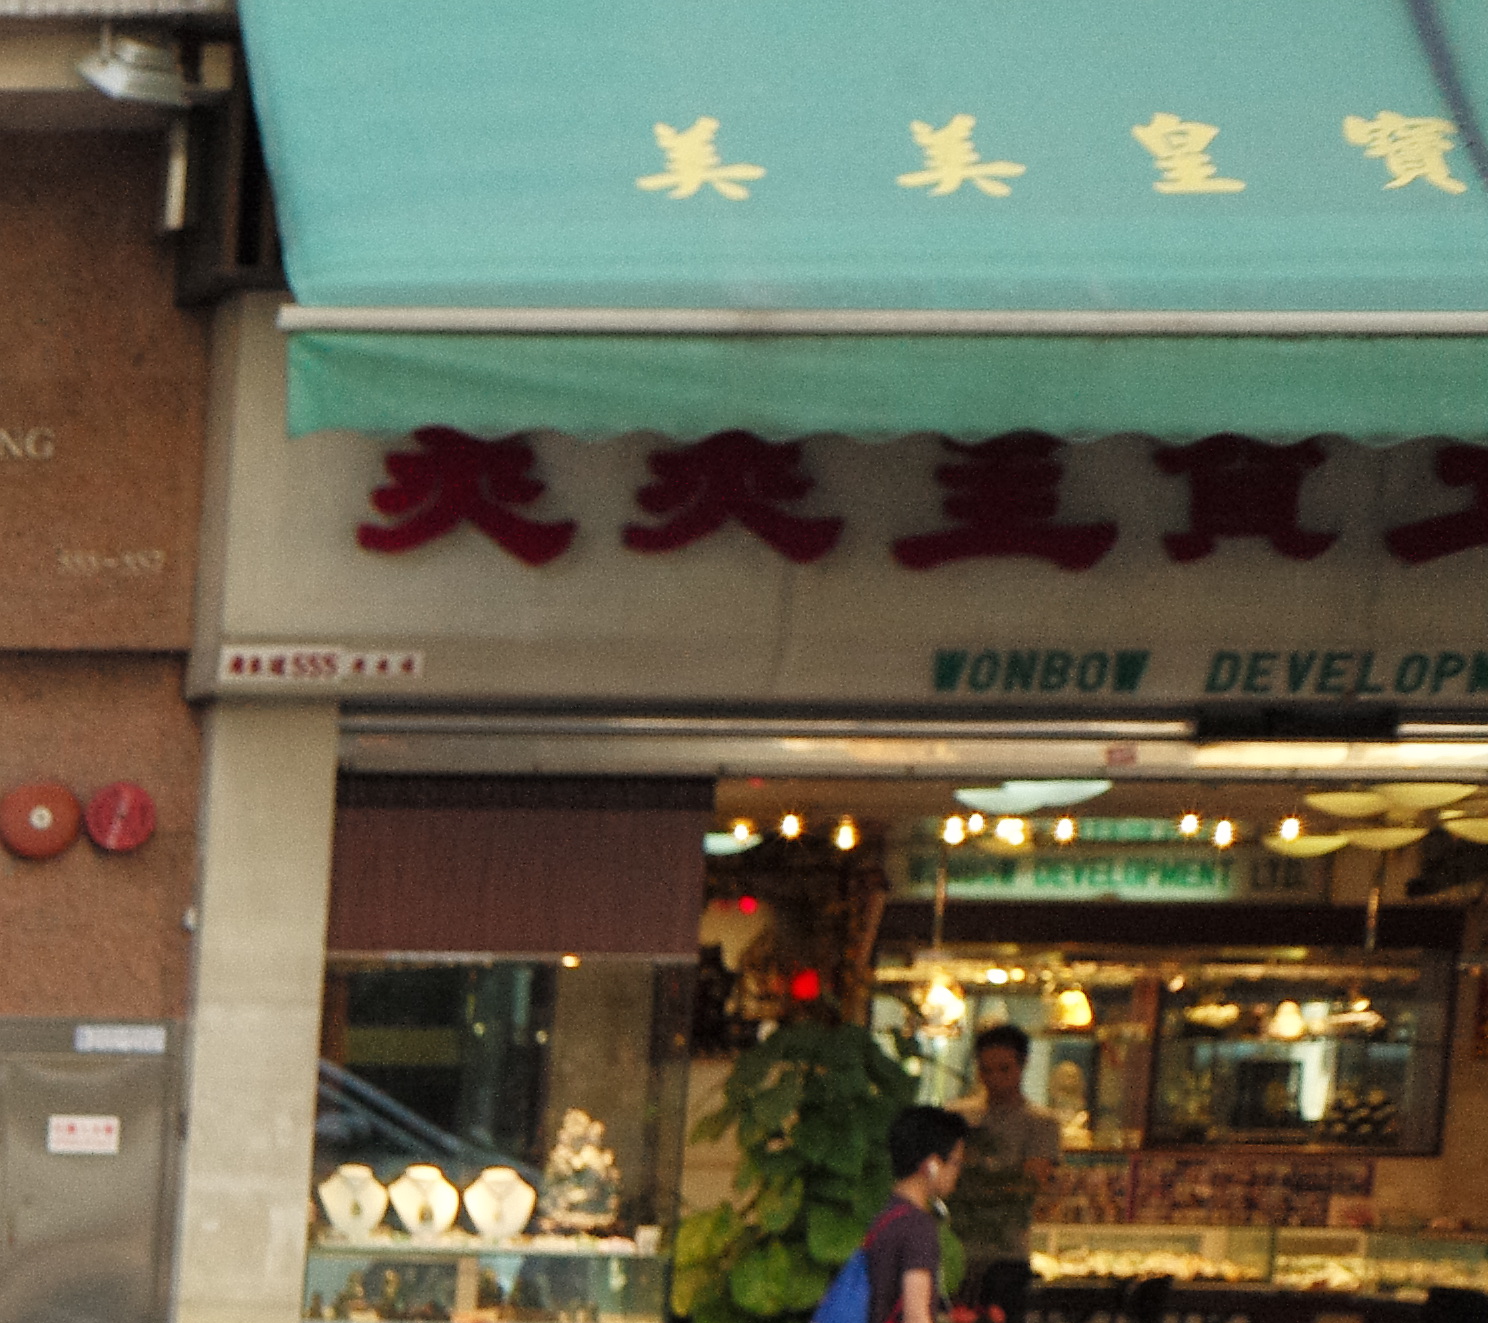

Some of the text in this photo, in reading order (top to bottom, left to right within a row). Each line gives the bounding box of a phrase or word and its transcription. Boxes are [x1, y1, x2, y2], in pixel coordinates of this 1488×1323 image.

[634, 110, 1467, 201] 美美皇寶
[932, 648, 1150, 693] WONBOW
